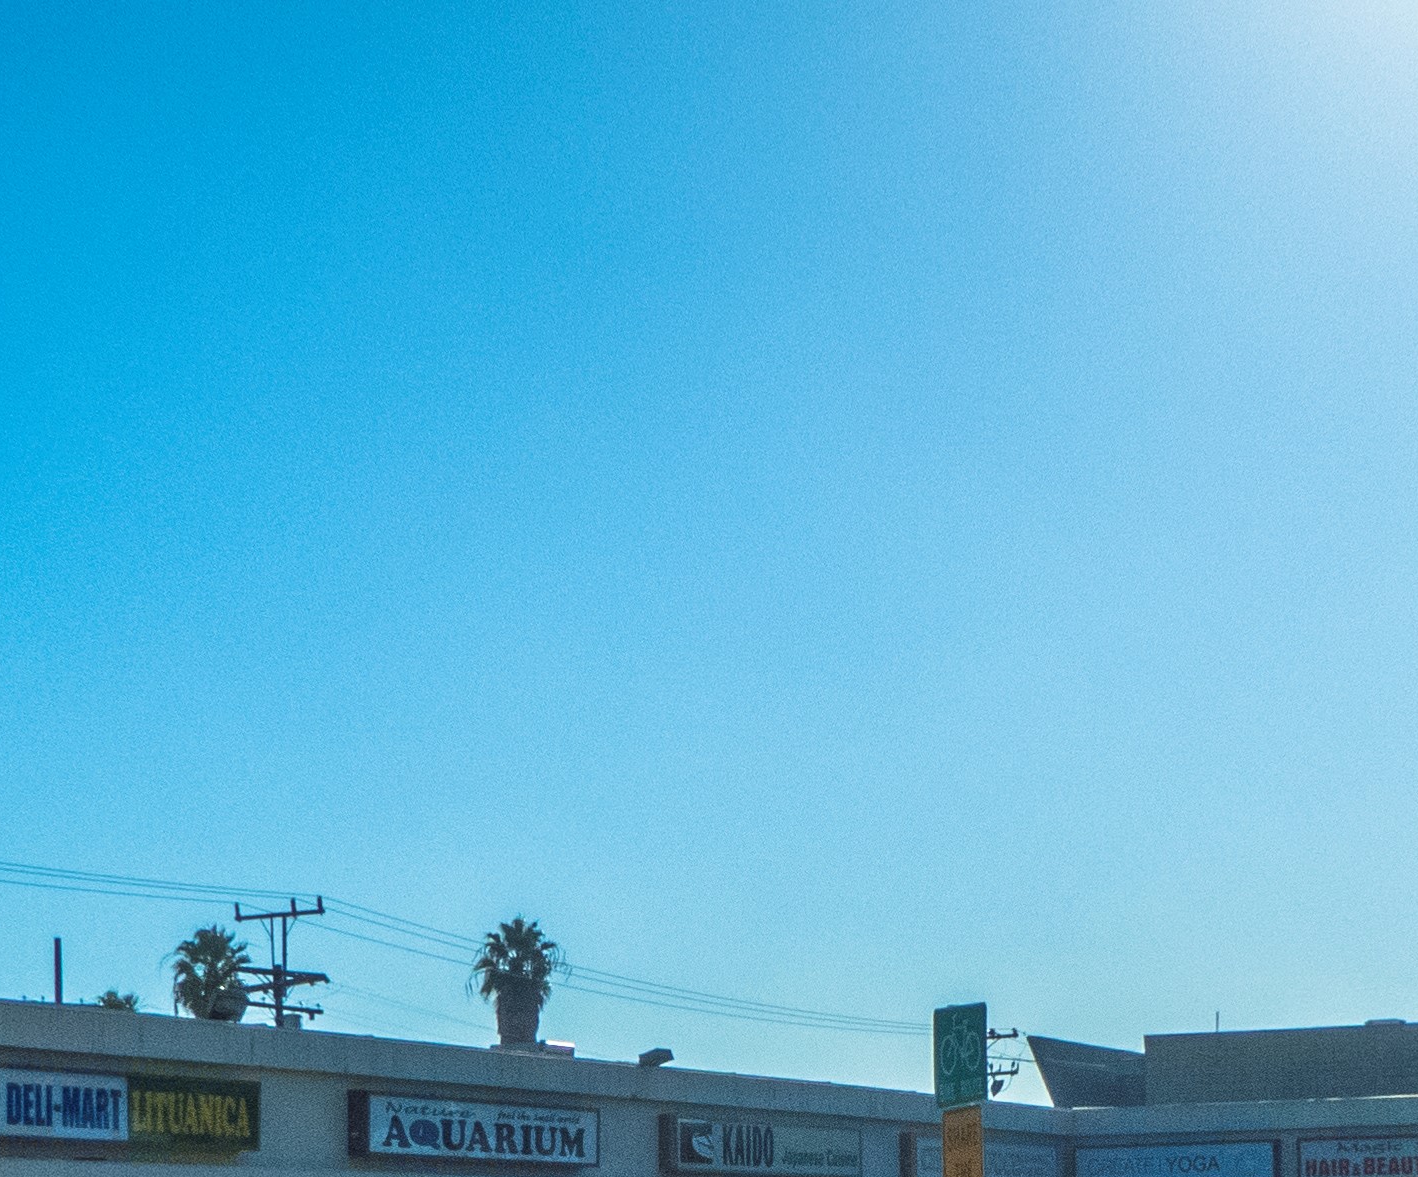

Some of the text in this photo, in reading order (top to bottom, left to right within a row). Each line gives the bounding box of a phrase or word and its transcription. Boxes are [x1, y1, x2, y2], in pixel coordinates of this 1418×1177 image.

[6, 1082, 122, 1131] DELI-MART
[133, 1089, 250, 1138] LITUANICA
[385, 1100, 474, 1119] Nature
[382, 1114, 586, 1158] AQUARIUM
[722, 1124, 774, 1168] KAIDO
[1165, 1155, 1221, 1173] YOGA
